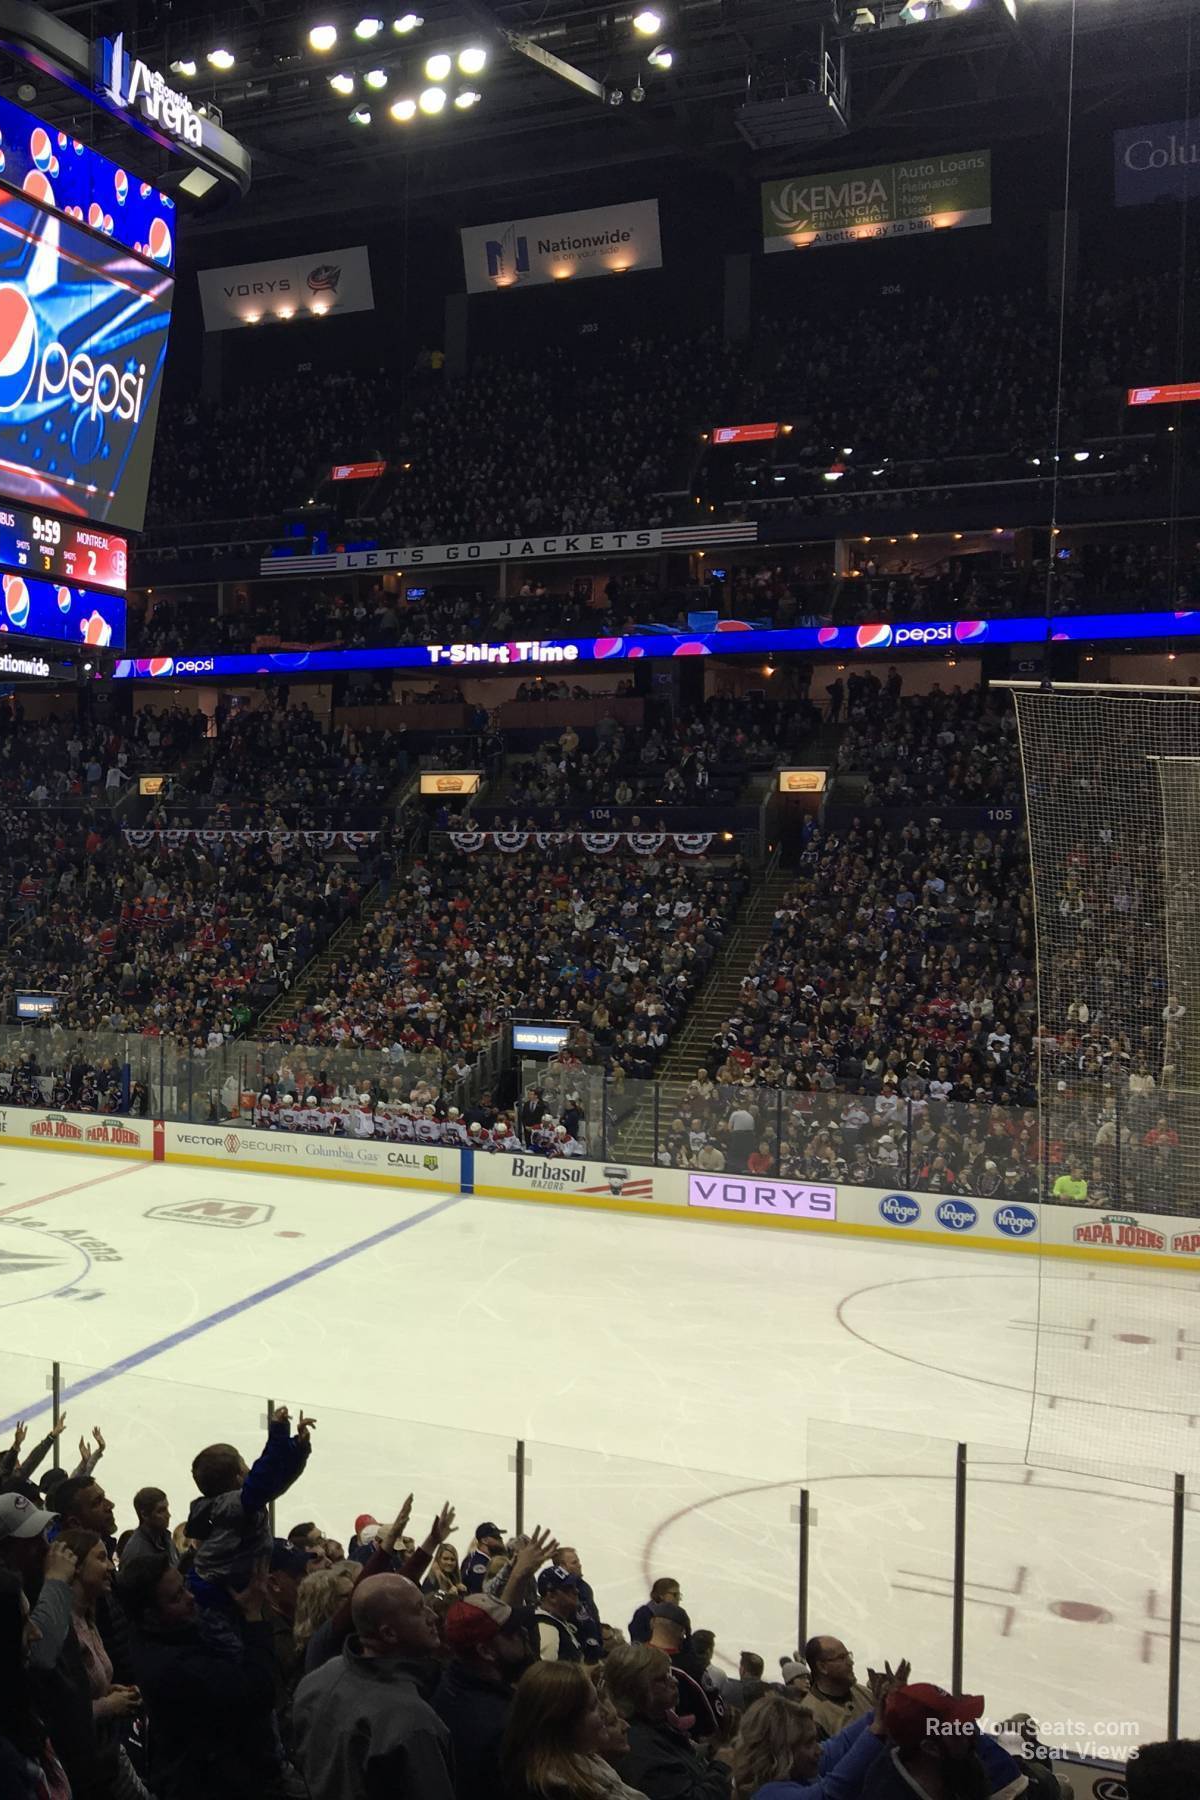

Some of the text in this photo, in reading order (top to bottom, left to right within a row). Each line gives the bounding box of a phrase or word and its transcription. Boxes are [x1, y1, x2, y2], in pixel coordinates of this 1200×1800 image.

[128, 59, 202, 147] Arena
[898, 156, 985, 181] Auto Loans
[792, 179, 888, 214] KEMBA
[812, 205, 888, 222] FINANCIAL
[855, 213, 888, 224] UNION
[538, 229, 631, 254] Nationwide
[814, 233, 822, 243] A
[826, 230, 861, 242] better
[893, 223, 904, 233] to
[909, 218, 937, 231] bank
[562, 252, 575, 260] on
[577, 249, 597, 261] your
[600, 245, 619, 256] side
[224, 279, 291, 297] VORYS
[38, 342, 146, 423] pepsi
[32, 516, 61, 544] 9:59
[76, 532, 110, 550] MONTREAL
[346, 533, 653, 567] LET'S GO JACKETS
[44, 557, 51, 570] 3
[87, 551, 97, 576] 2
[895, 622, 952, 645] pepsi
[427, 641, 579, 663] T-Shirt Time
[176, 656, 214, 674] pepsi
[589, 809, 610, 819] 104
[987, 810, 1013, 821] 105
[31, 1121, 82, 1139] PAPA JOHNS
[87, 1126, 139, 1146] PAPA JOHNS
[177, 1134, 298, 1154] VECTOR SECURITY
[305, 1143, 378, 1161] Columbia Gas
[388, 1152, 420, 1165] CALL
[511, 1157, 586, 1184] Barbasol
[531, 1180, 564, 1191] RAZORS
[694, 1180, 832, 1212] VORYS
[884, 1198, 918, 1222] Kroger
[939, 1203, 975, 1228] Kroger
[997, 1208, 1034, 1234] Kroger
[47, 1227, 123, 1265] Arena
[1076, 1224, 1165, 1250] PAPA JOHNS
